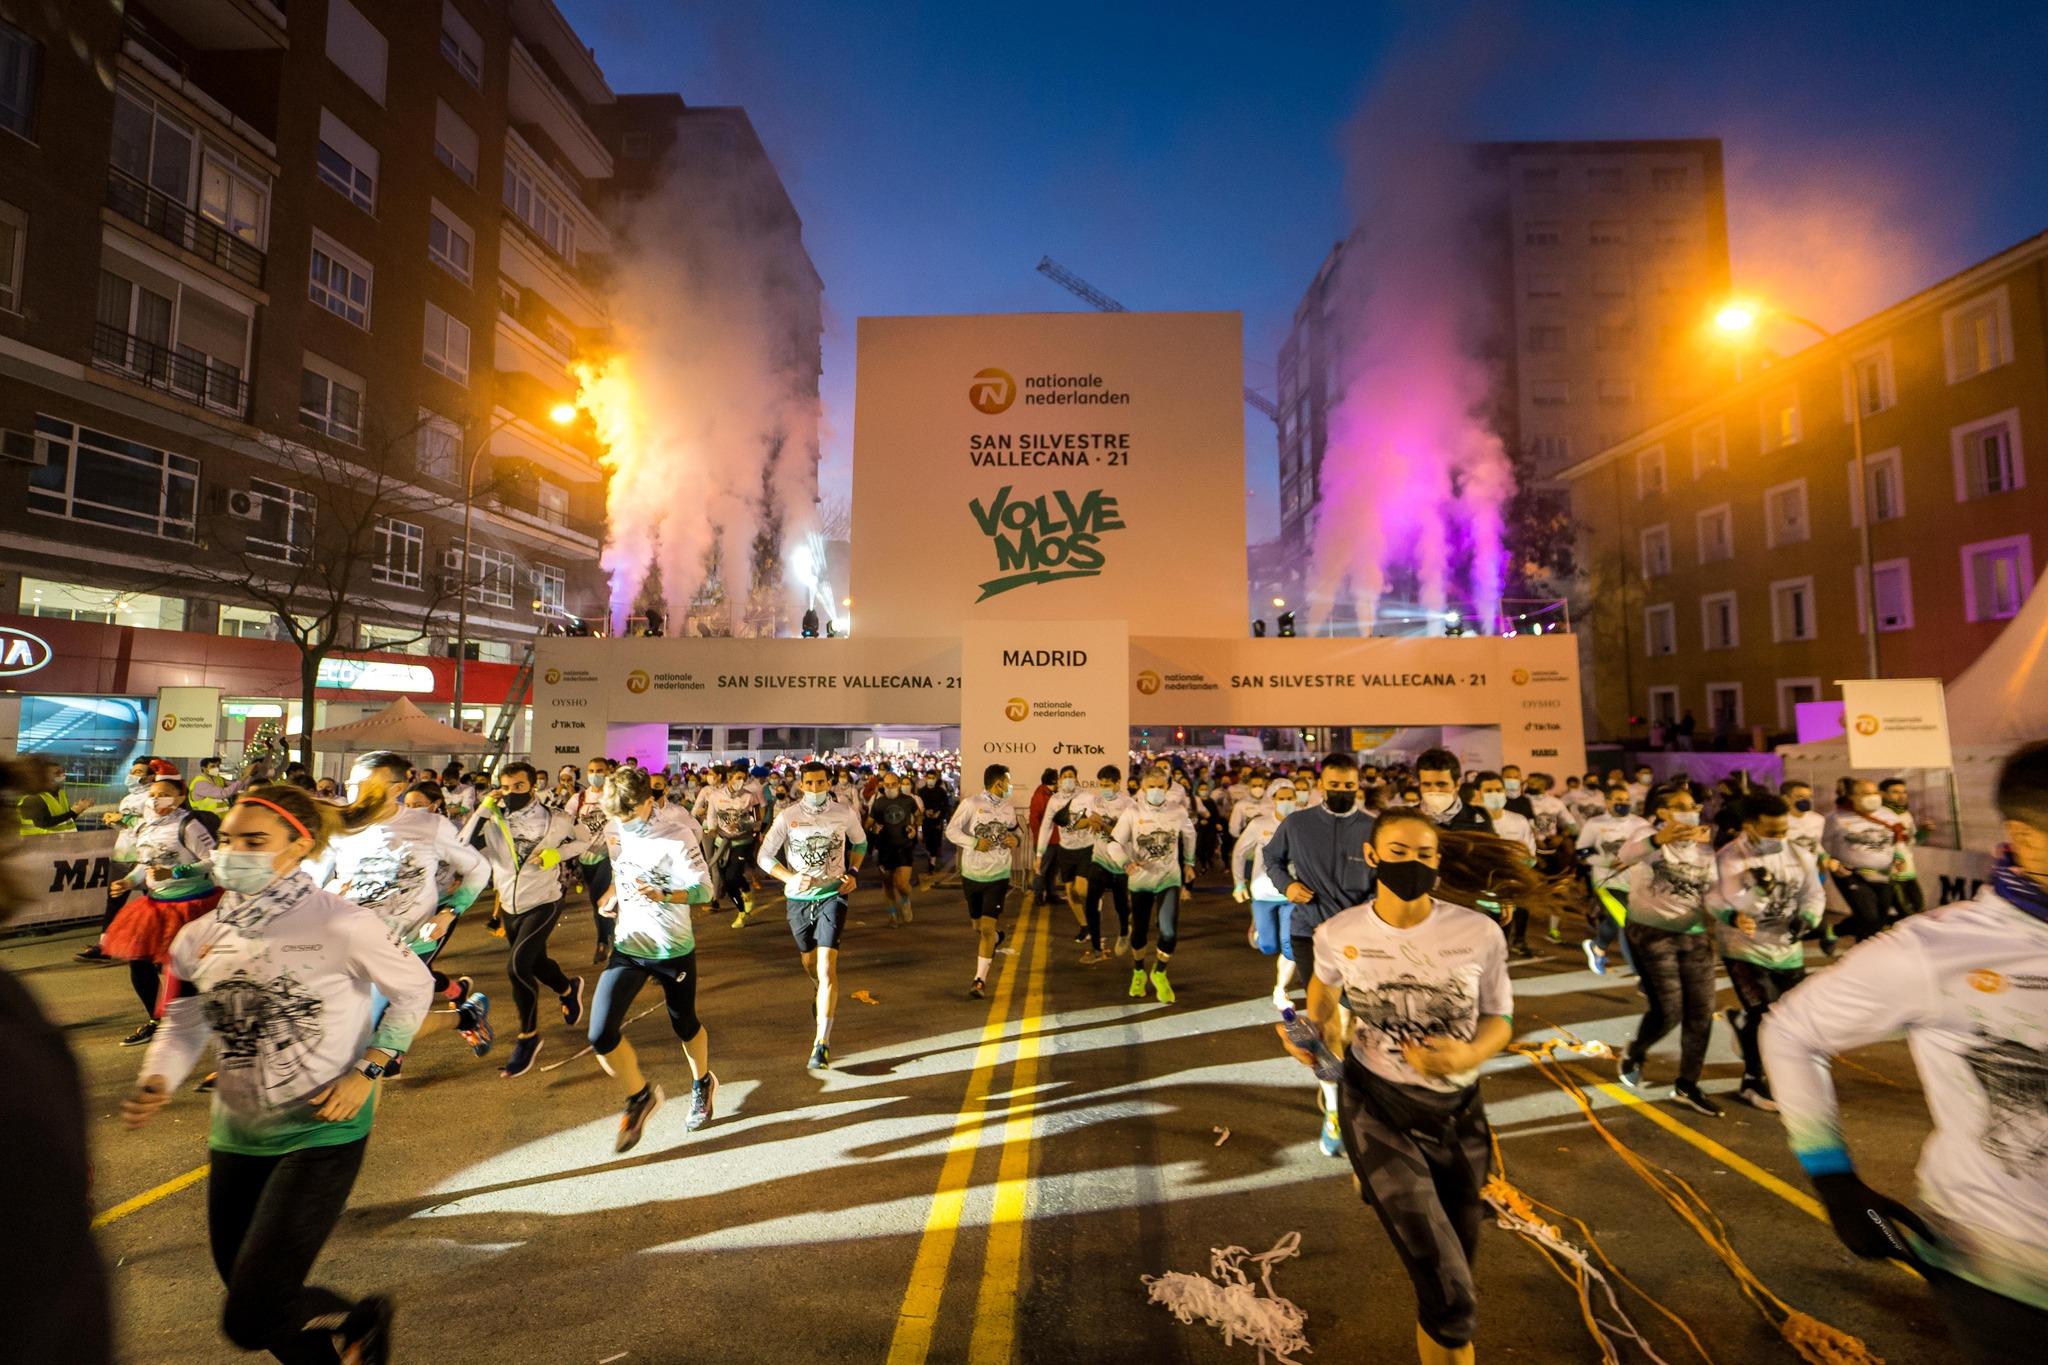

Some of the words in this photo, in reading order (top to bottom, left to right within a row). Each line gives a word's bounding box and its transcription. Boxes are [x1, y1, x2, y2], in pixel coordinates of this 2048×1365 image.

[1025, 374, 1103, 388] nationale
[1025, 390, 1130, 405] nederlanden
[970, 434, 1012, 450] SAN
[1019, 433, 1131, 449] SILVESTRE
[970, 451, 1090, 466] VALLECANA
[1107, 451, 1129, 466] 21
[968, 484, 1127, 537] VOLVE
[993, 526, 1106, 572] MOS
[1003, 650, 1087, 667] MADRID
[654, 673, 693, 682] nationale
[718, 675, 749, 689] SAN
[754, 675, 837, 689] SILVESTRE
[843, 675, 933, 689] VALLECANA
[946, 676, 962, 689] 21
[1164, 673, 1204, 682] nationale
[1231, 675, 1264, 688] SAN
[1269, 675, 1356, 688] SILVESTRE
[1362, 674, 1456, 687] VALLECANA
[1469, 673, 1487, 686] 21
[654, 682, 705, 690] nederlanden
[1164, 682, 1219, 691] nederlanden
[552, 699, 588, 707] OYSHO
[1033, 701, 1073, 709] nationale
[1033, 709, 1087, 718] nederlanden
[560, 721, 586, 729] TikTok
[554, 745, 581, 754] MARCA
[983, 742, 1037, 754] OYSHO
[1067, 744, 1105, 754] TikTok
